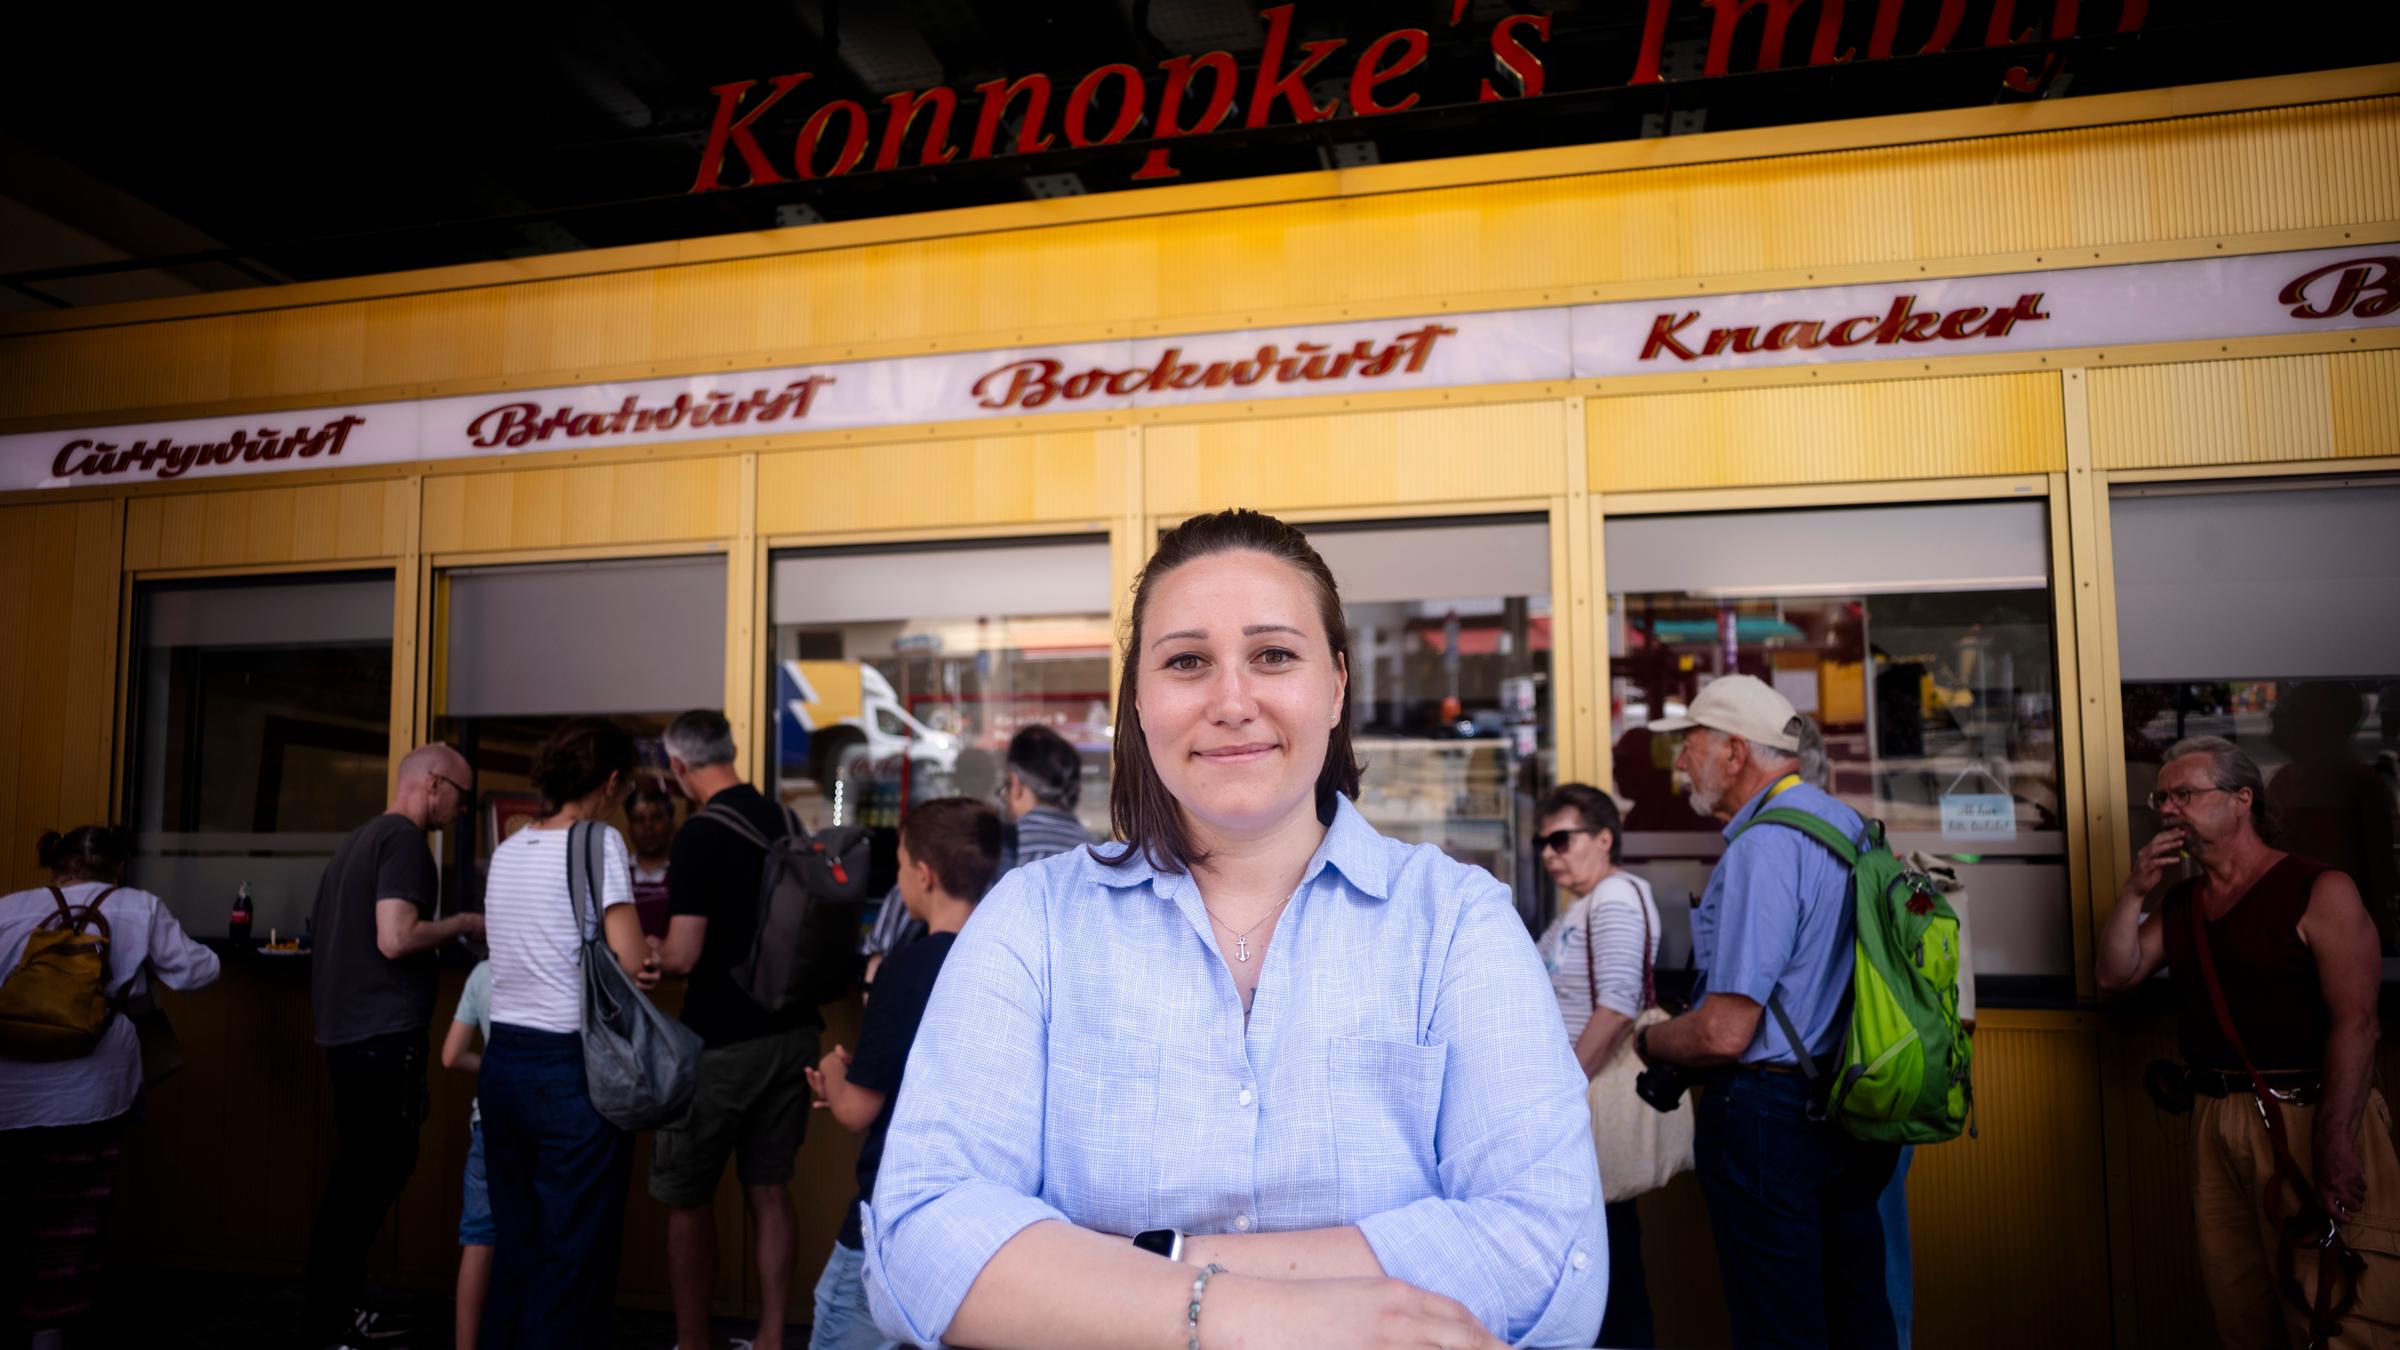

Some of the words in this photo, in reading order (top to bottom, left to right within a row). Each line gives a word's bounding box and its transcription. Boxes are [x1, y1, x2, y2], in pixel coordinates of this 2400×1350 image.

[688, 0, 1550, 194] Konnopke's
[1639, 293, 2050, 361] Knacker
[971, 325, 1459, 409] Bockwurst
[51, 415, 366, 478] Currywurst
[466, 375, 837, 448] Bratwurst
